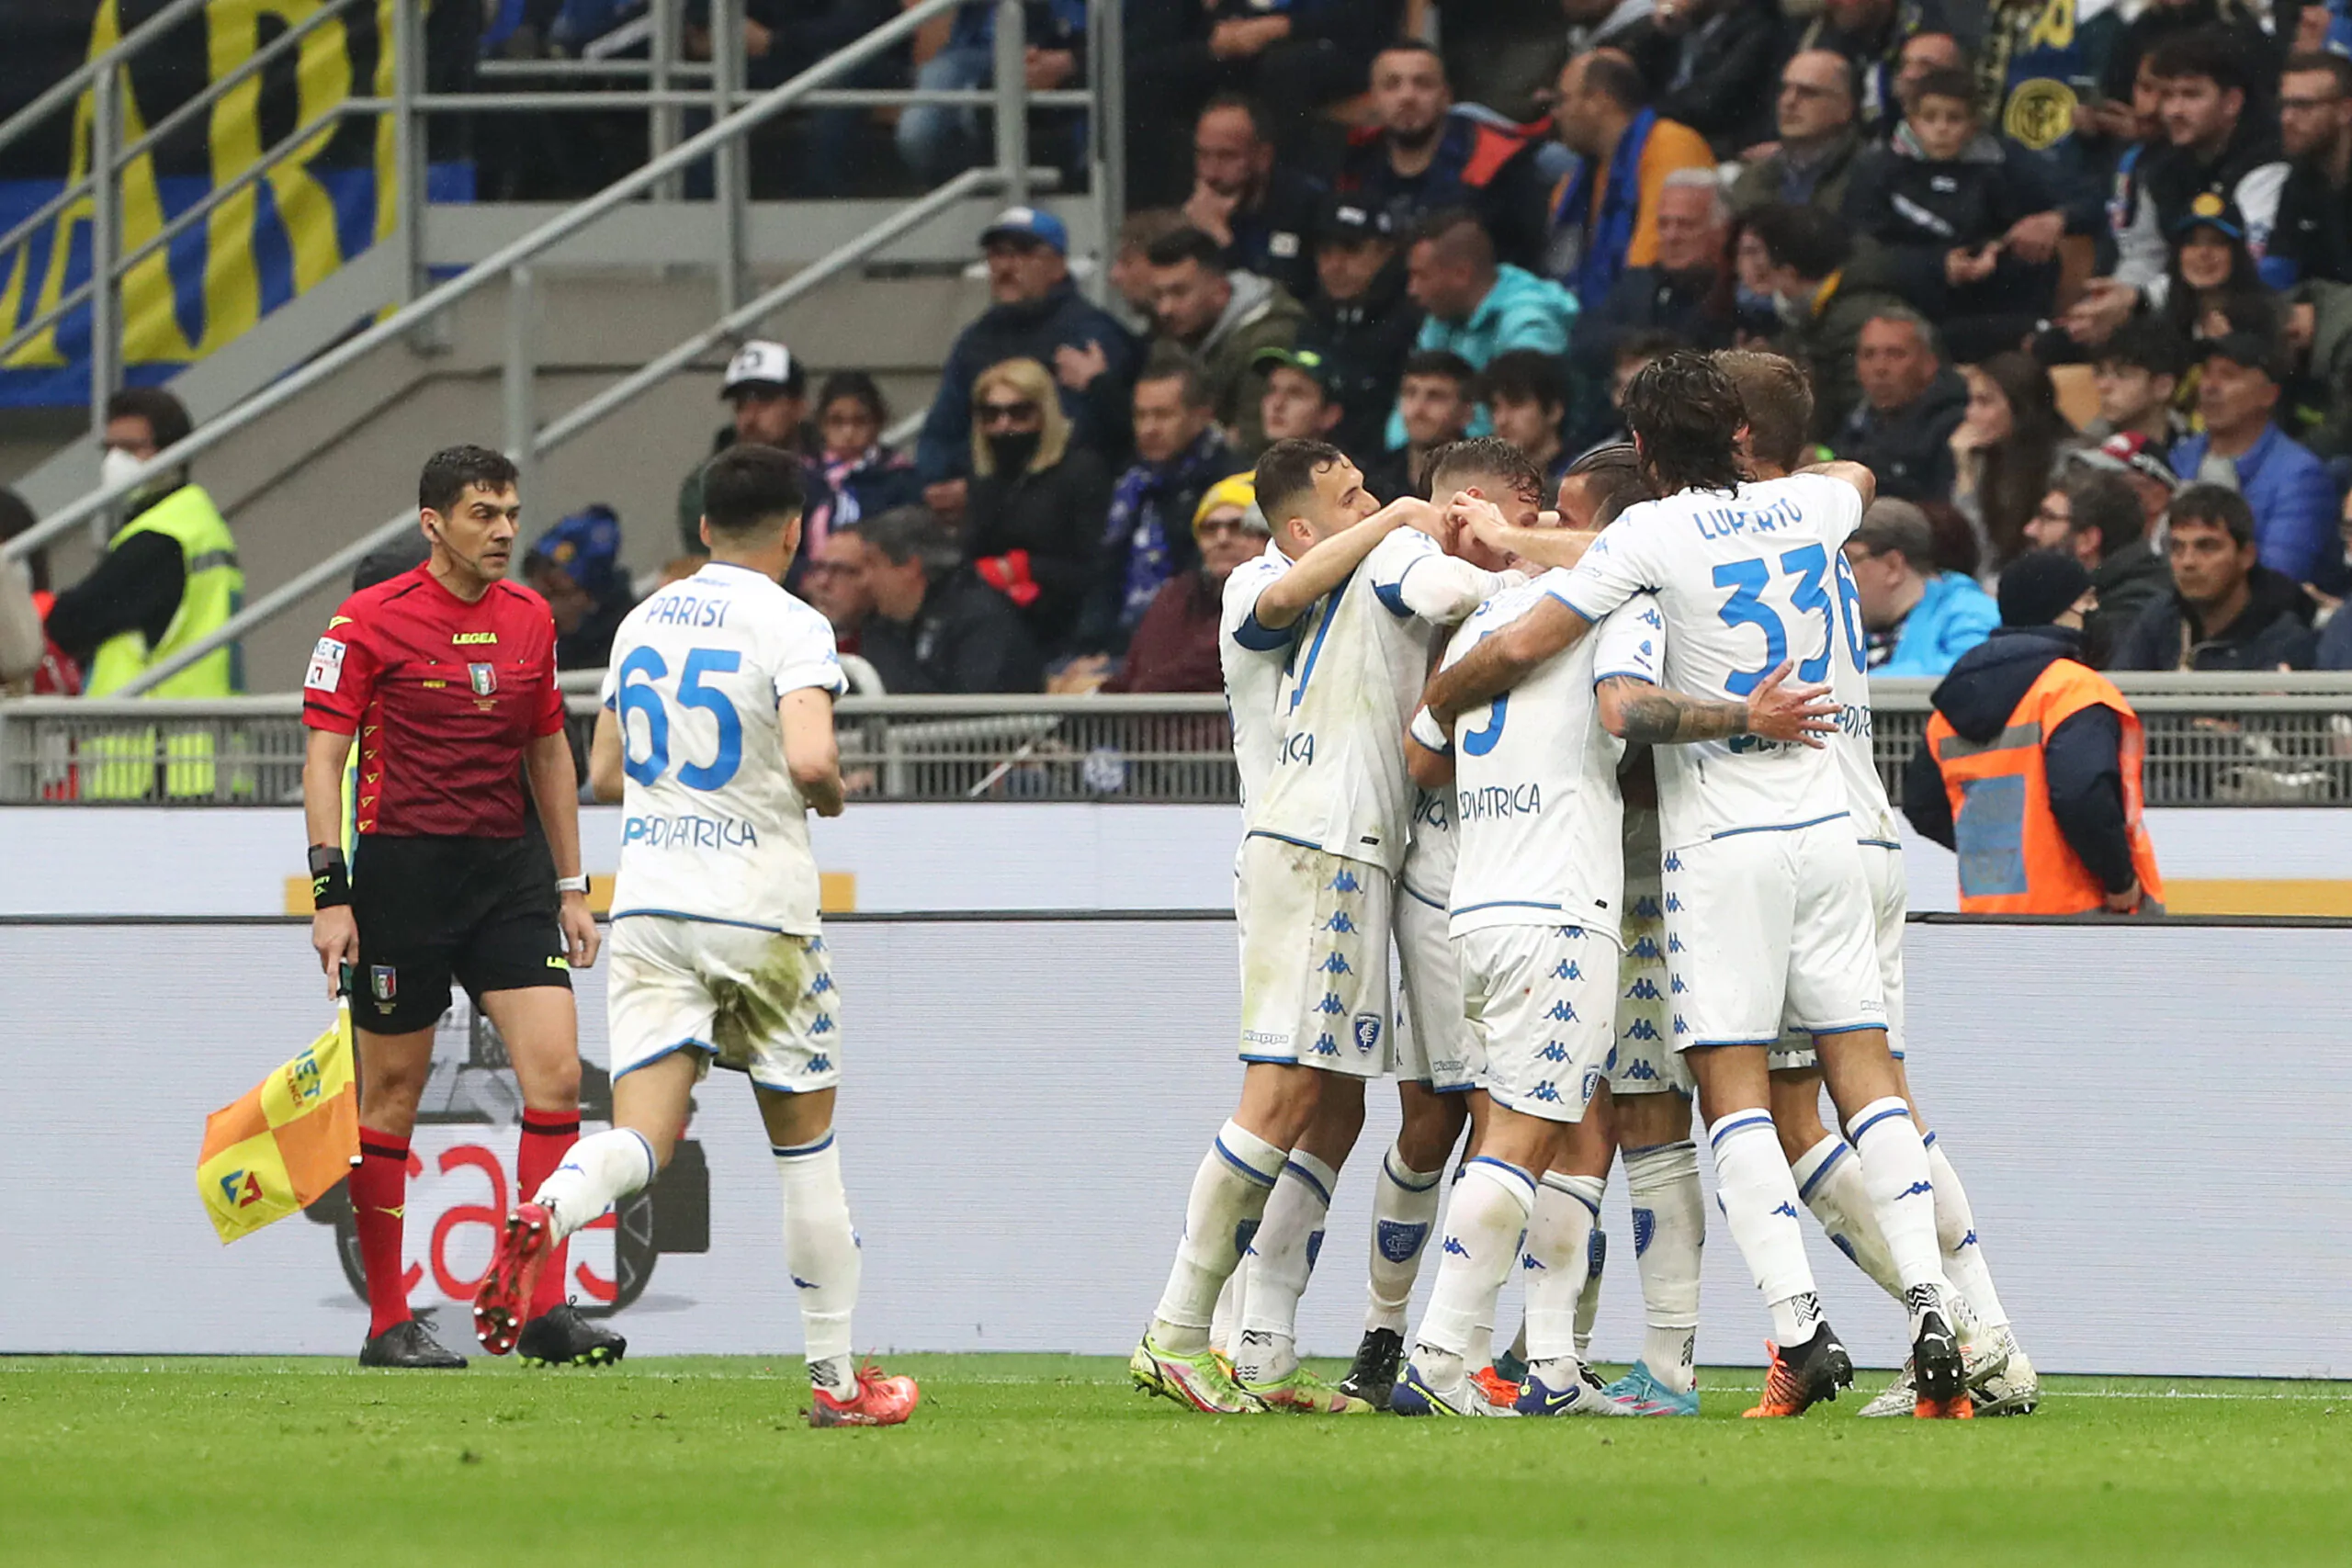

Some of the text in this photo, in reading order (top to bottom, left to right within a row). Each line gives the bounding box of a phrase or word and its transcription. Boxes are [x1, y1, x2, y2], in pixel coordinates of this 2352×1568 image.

[645, 596, 731, 628] PARISI
[1713, 543, 1834, 696] 33
[452, 632, 498, 645] LEGEA
[618, 645, 742, 791] 65
[1276, 732, 1315, 765] ICA
[1459, 783, 1541, 822] DIATRICA
[621, 814, 758, 851] PEDIATRICA
[1242, 1029, 1289, 1044] Kappa
